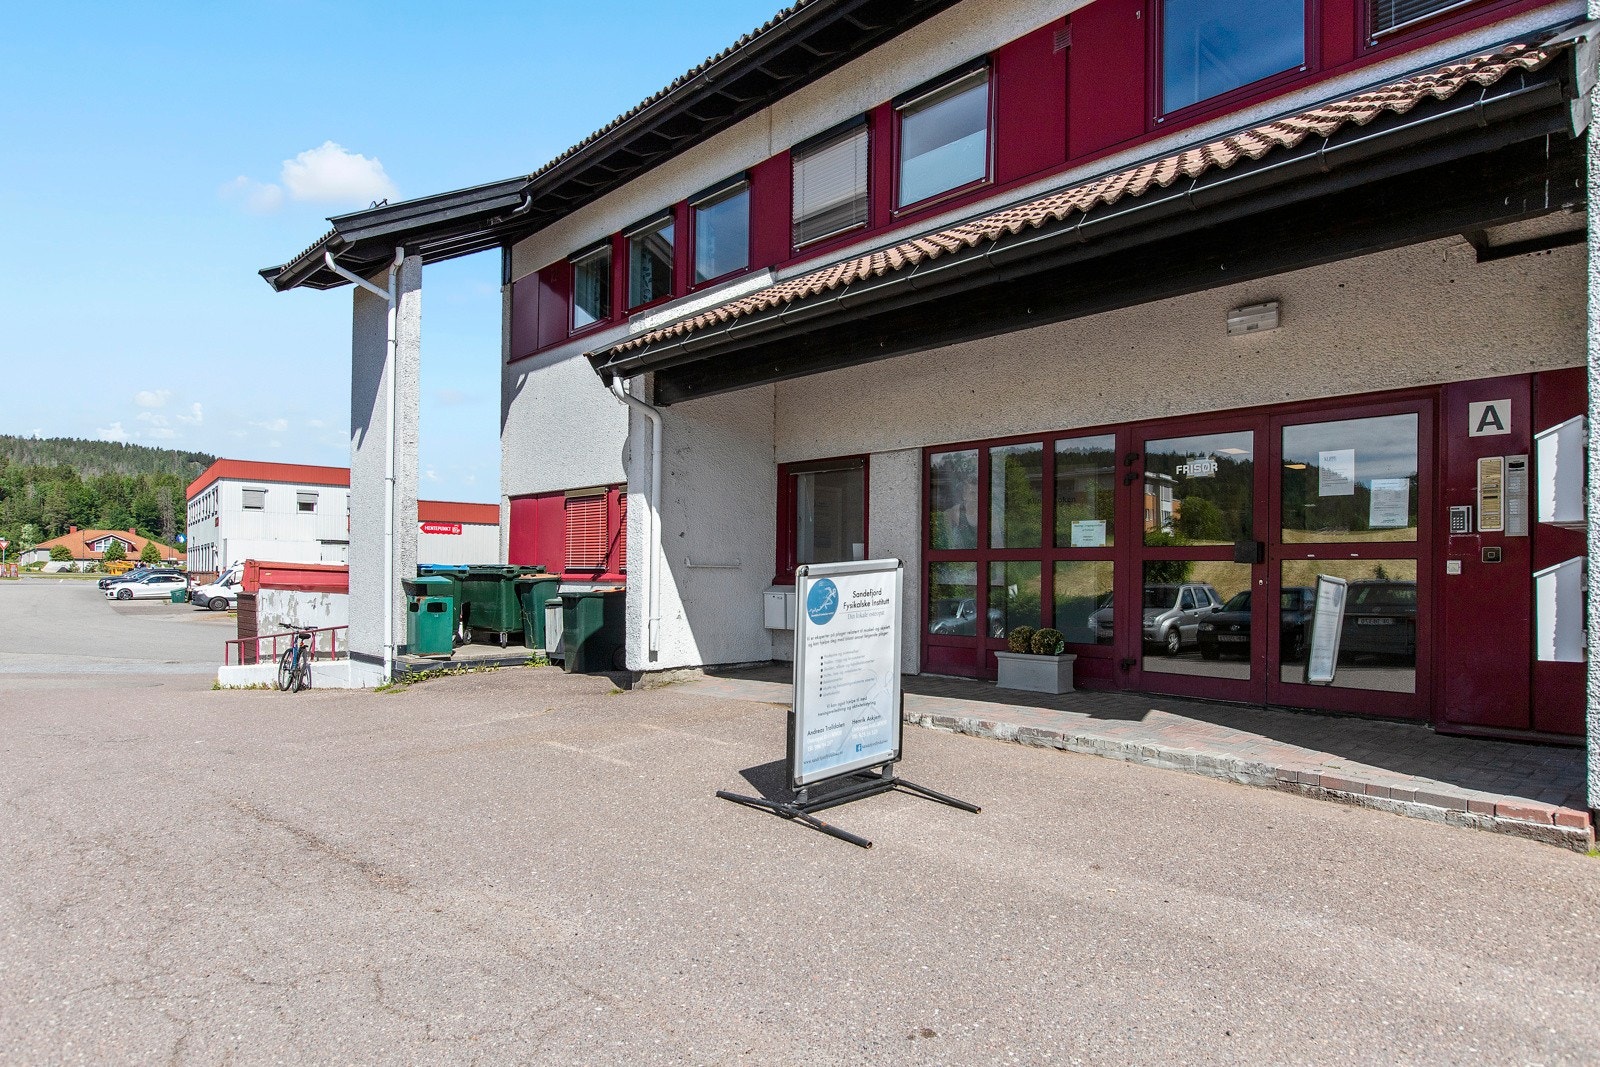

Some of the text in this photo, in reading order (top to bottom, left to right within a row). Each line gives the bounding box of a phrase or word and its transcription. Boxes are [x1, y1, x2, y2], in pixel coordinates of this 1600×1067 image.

[1476, 404, 1504, 432] A
[1175, 462, 1218, 475] FRISØR
[852, 588, 882, 599] Sandefjord
[843, 598, 890, 611] Fysikalske Institutt
[852, 717, 866, 726] Henrik
[806, 727, 825, 737] Andreas
